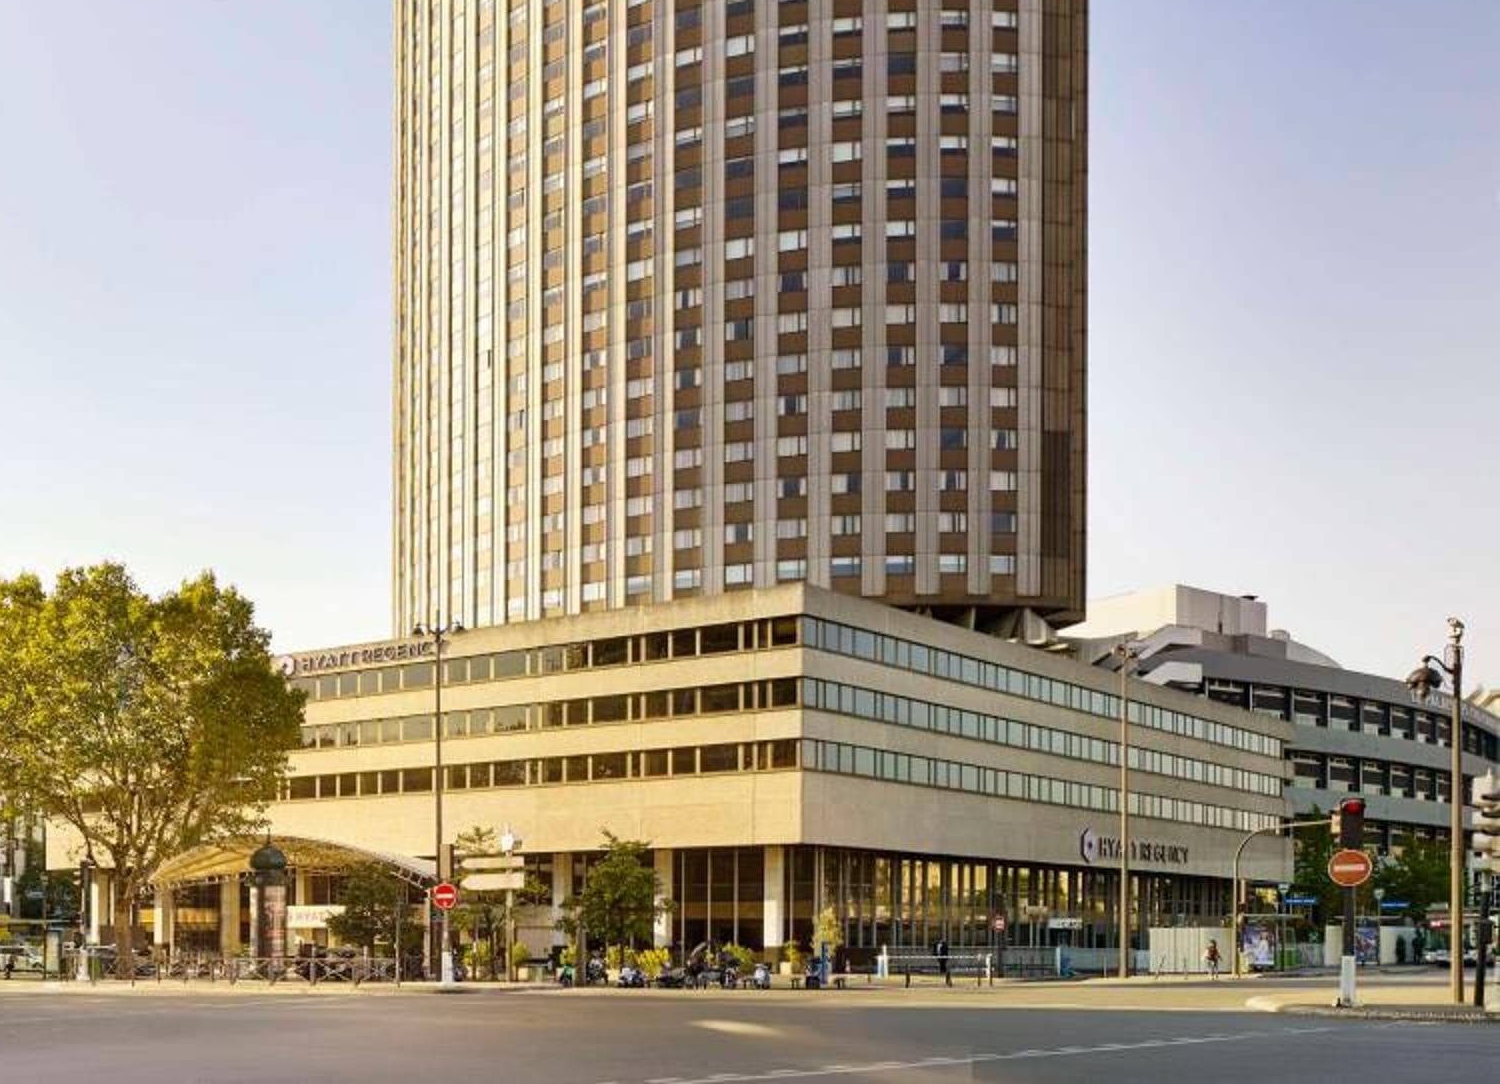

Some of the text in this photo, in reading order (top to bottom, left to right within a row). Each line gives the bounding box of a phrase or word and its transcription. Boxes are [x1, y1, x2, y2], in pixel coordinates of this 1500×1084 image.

[302, 640, 438, 674] HYATT REGENC
[1098, 836, 1138, 861] HYAT
